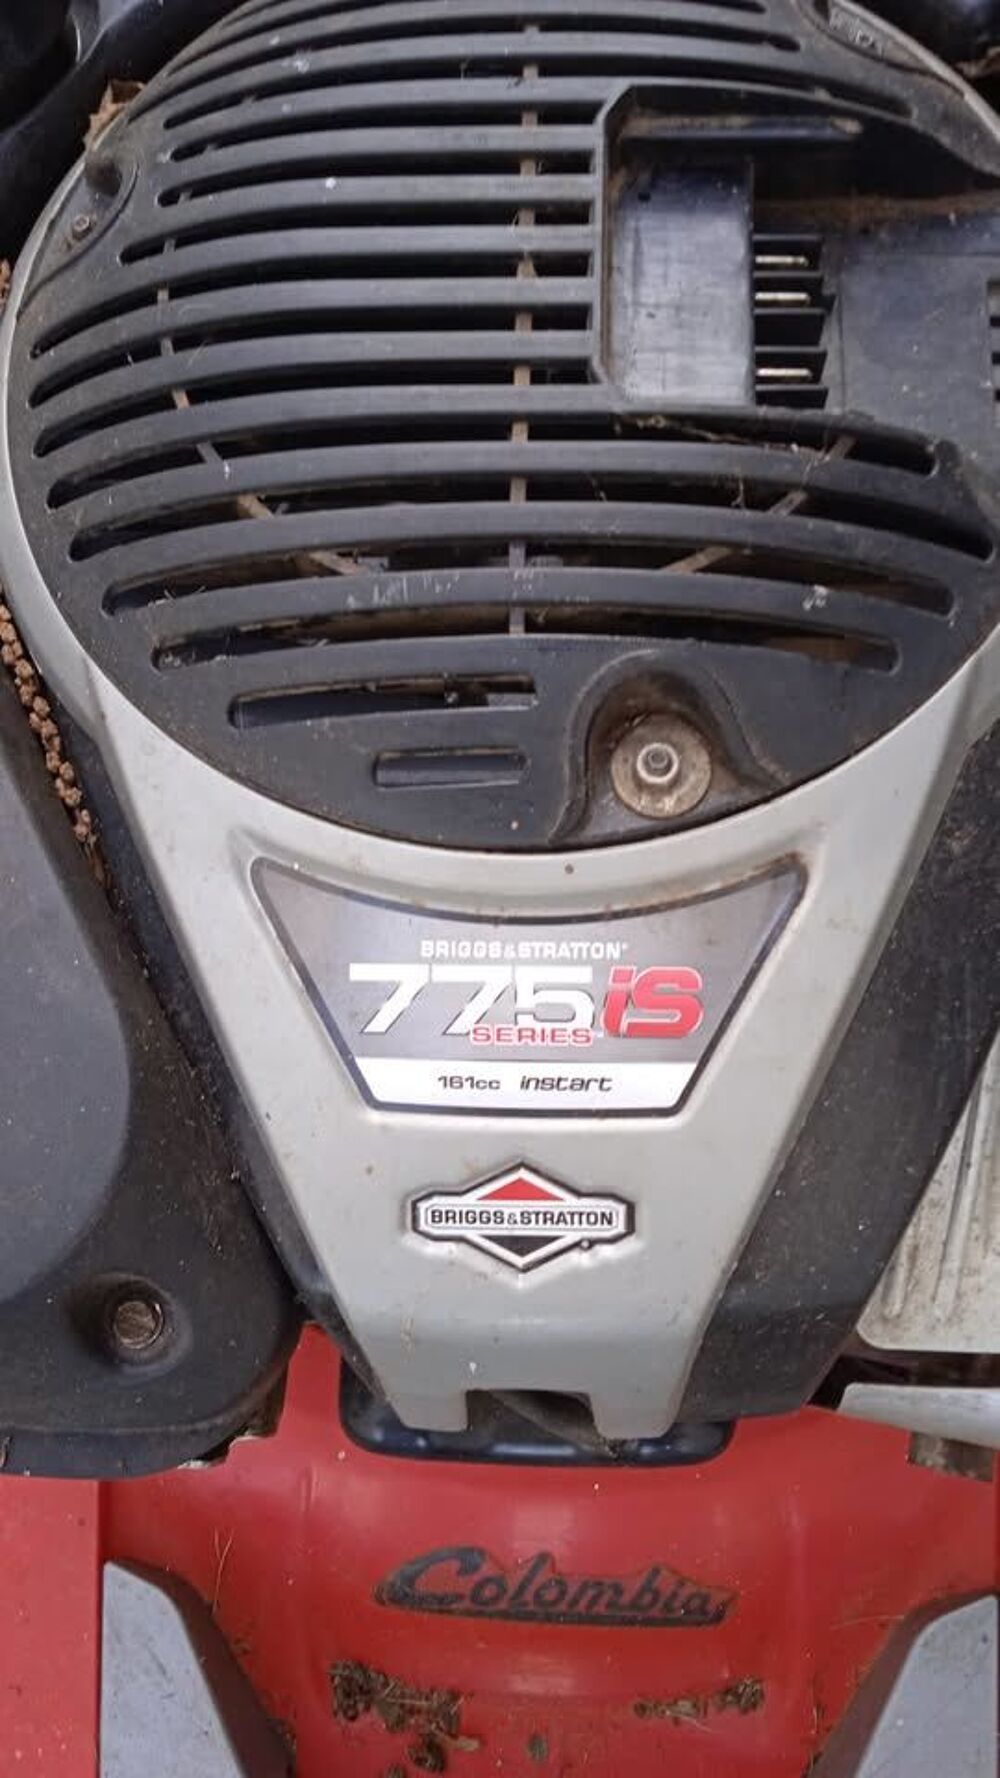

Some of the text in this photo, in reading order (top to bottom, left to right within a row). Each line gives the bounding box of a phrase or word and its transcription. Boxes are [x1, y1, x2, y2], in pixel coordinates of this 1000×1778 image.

[470, 1025, 593, 1046] SERIES
[437, 1074, 613, 1093] 161cc instart
[375, 1545, 728, 1617] Colombia
